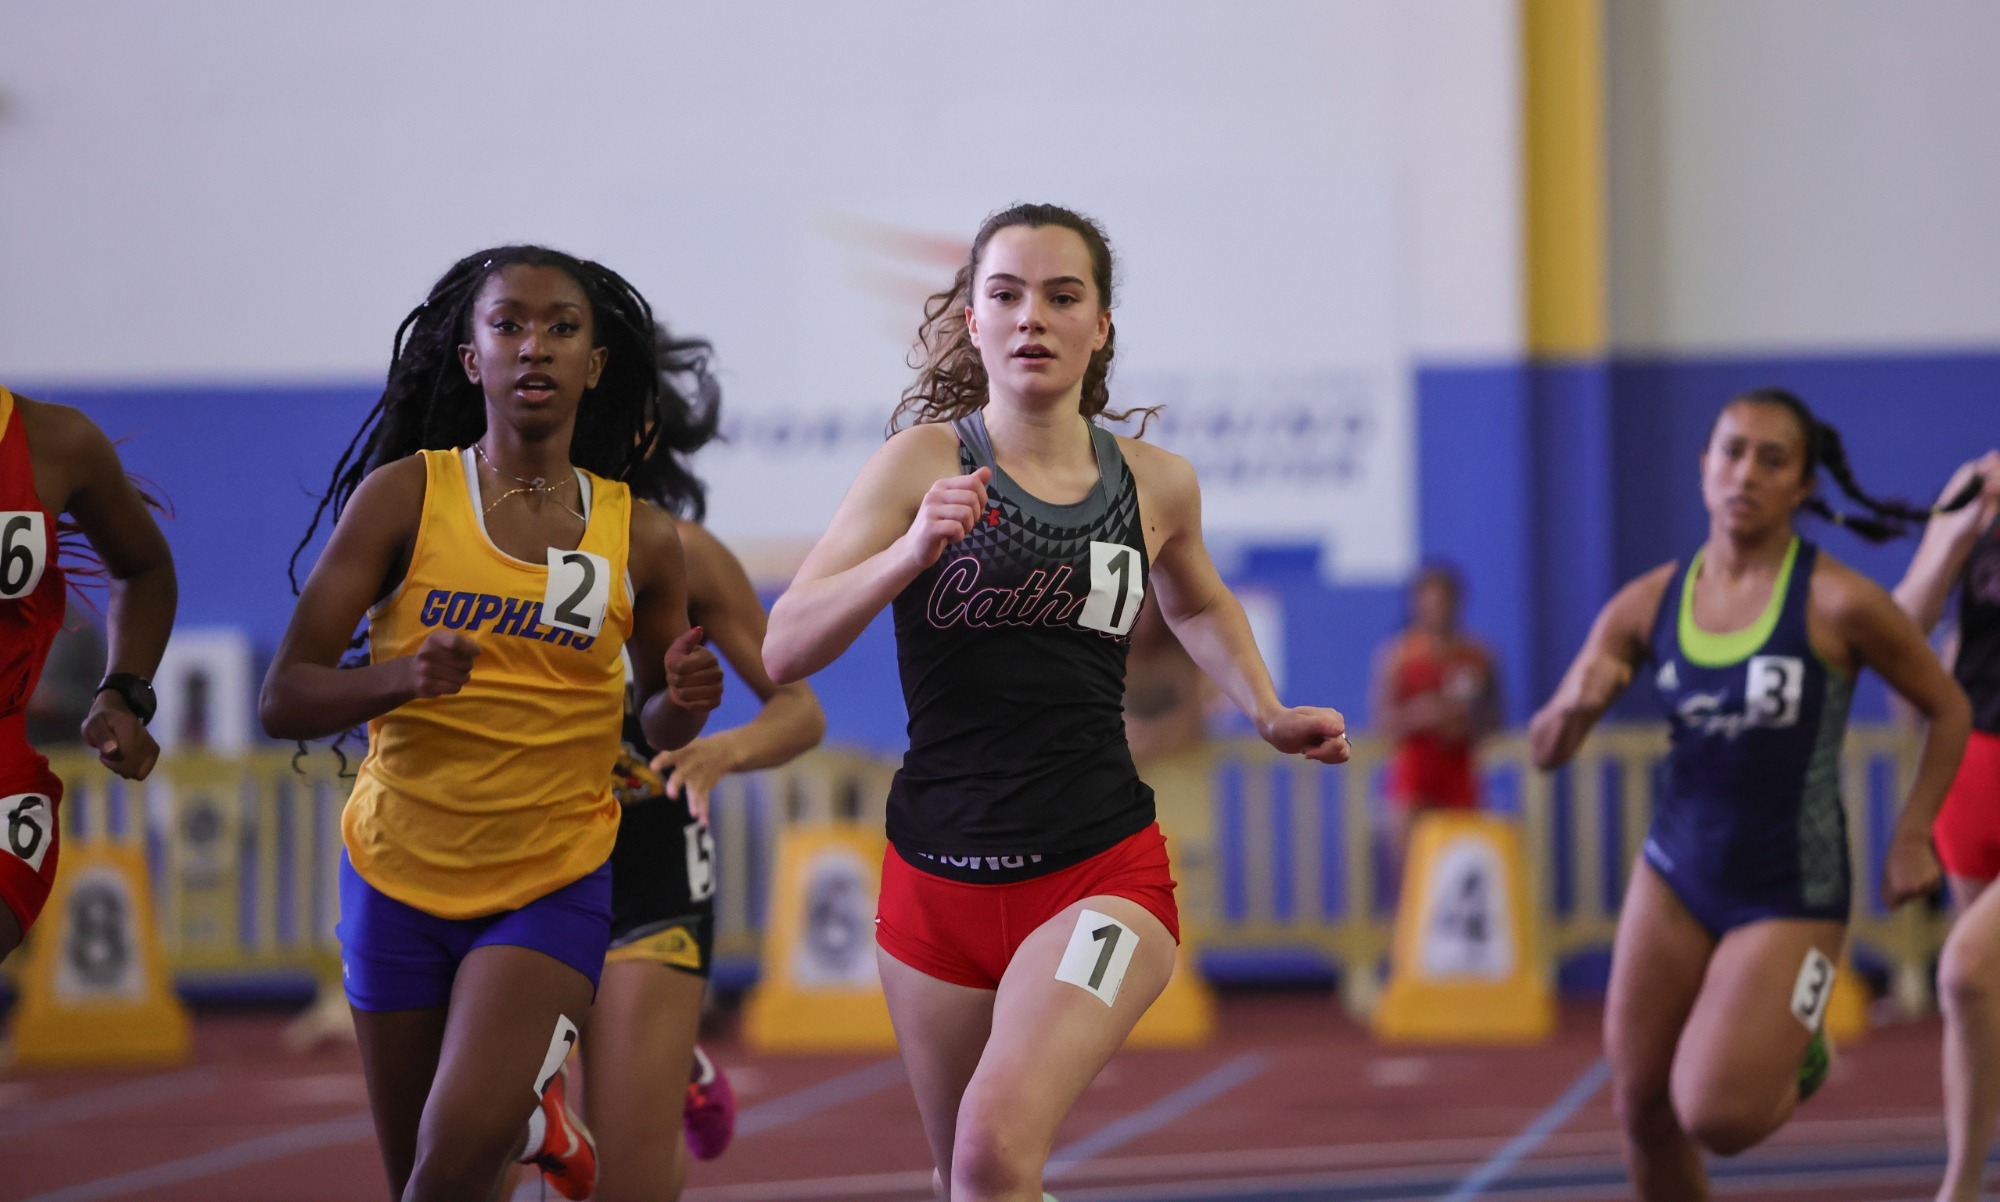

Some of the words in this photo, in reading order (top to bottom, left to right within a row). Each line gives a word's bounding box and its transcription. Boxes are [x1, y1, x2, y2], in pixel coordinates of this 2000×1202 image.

[0, 516, 34, 596] 6
[554, 553, 596, 630] 2
[1107, 549, 1130, 629] 1
[1764, 664, 1787, 719] 3
[7, 795, 44, 860] 6
[70, 882, 130, 985] 8
[807, 874, 868, 972] 6
[1431, 866, 1491, 957] 4
[1092, 923, 1122, 990] 1
[1799, 958, 1828, 1017] 3
